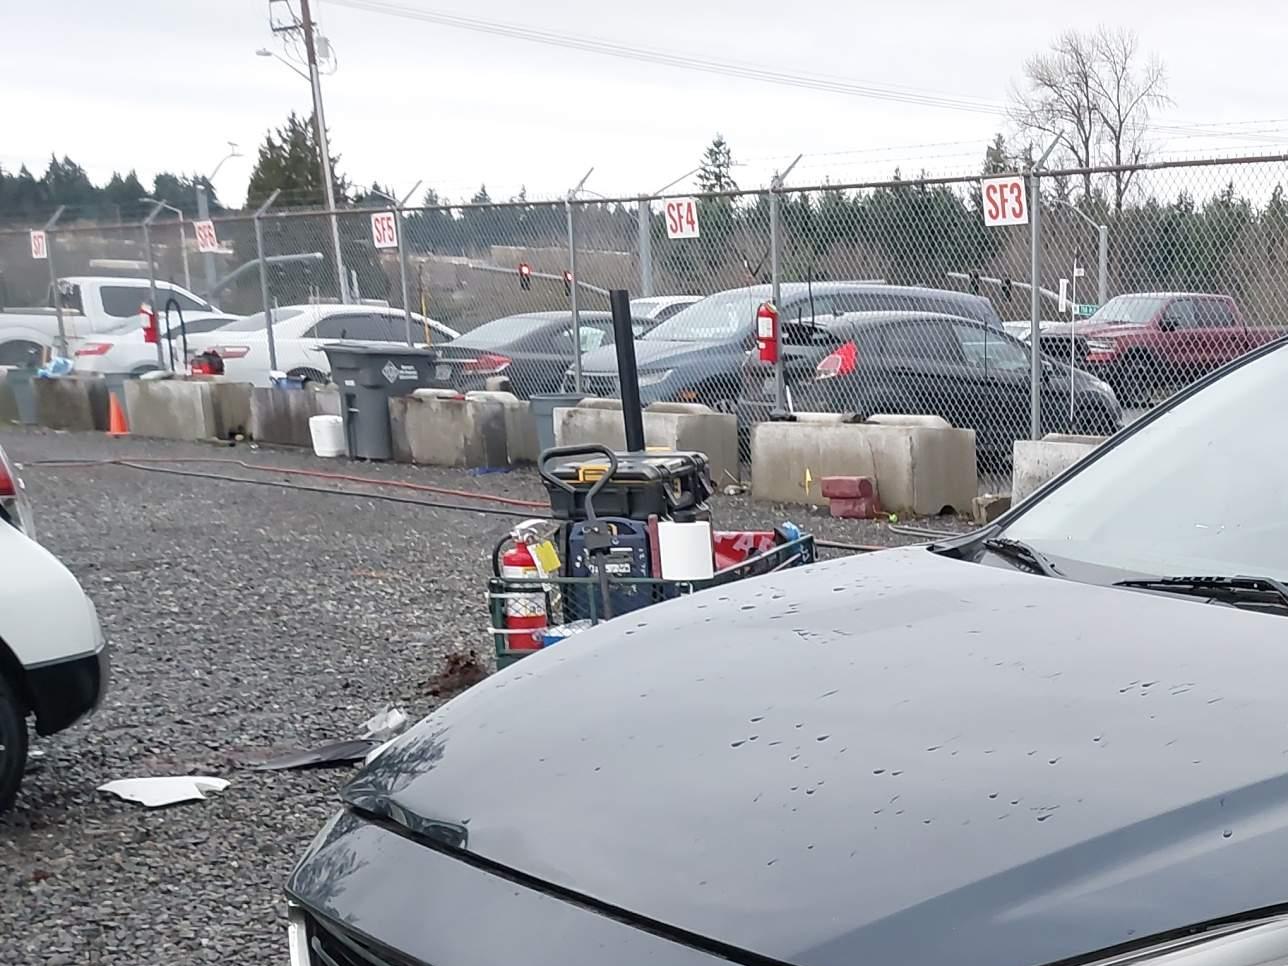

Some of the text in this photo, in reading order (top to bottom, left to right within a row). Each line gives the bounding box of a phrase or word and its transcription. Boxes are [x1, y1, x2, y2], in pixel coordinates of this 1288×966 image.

[985, 182, 1024, 220] SF3
[374, 216, 395, 243] SF5
[667, 202, 696, 234] SF4
